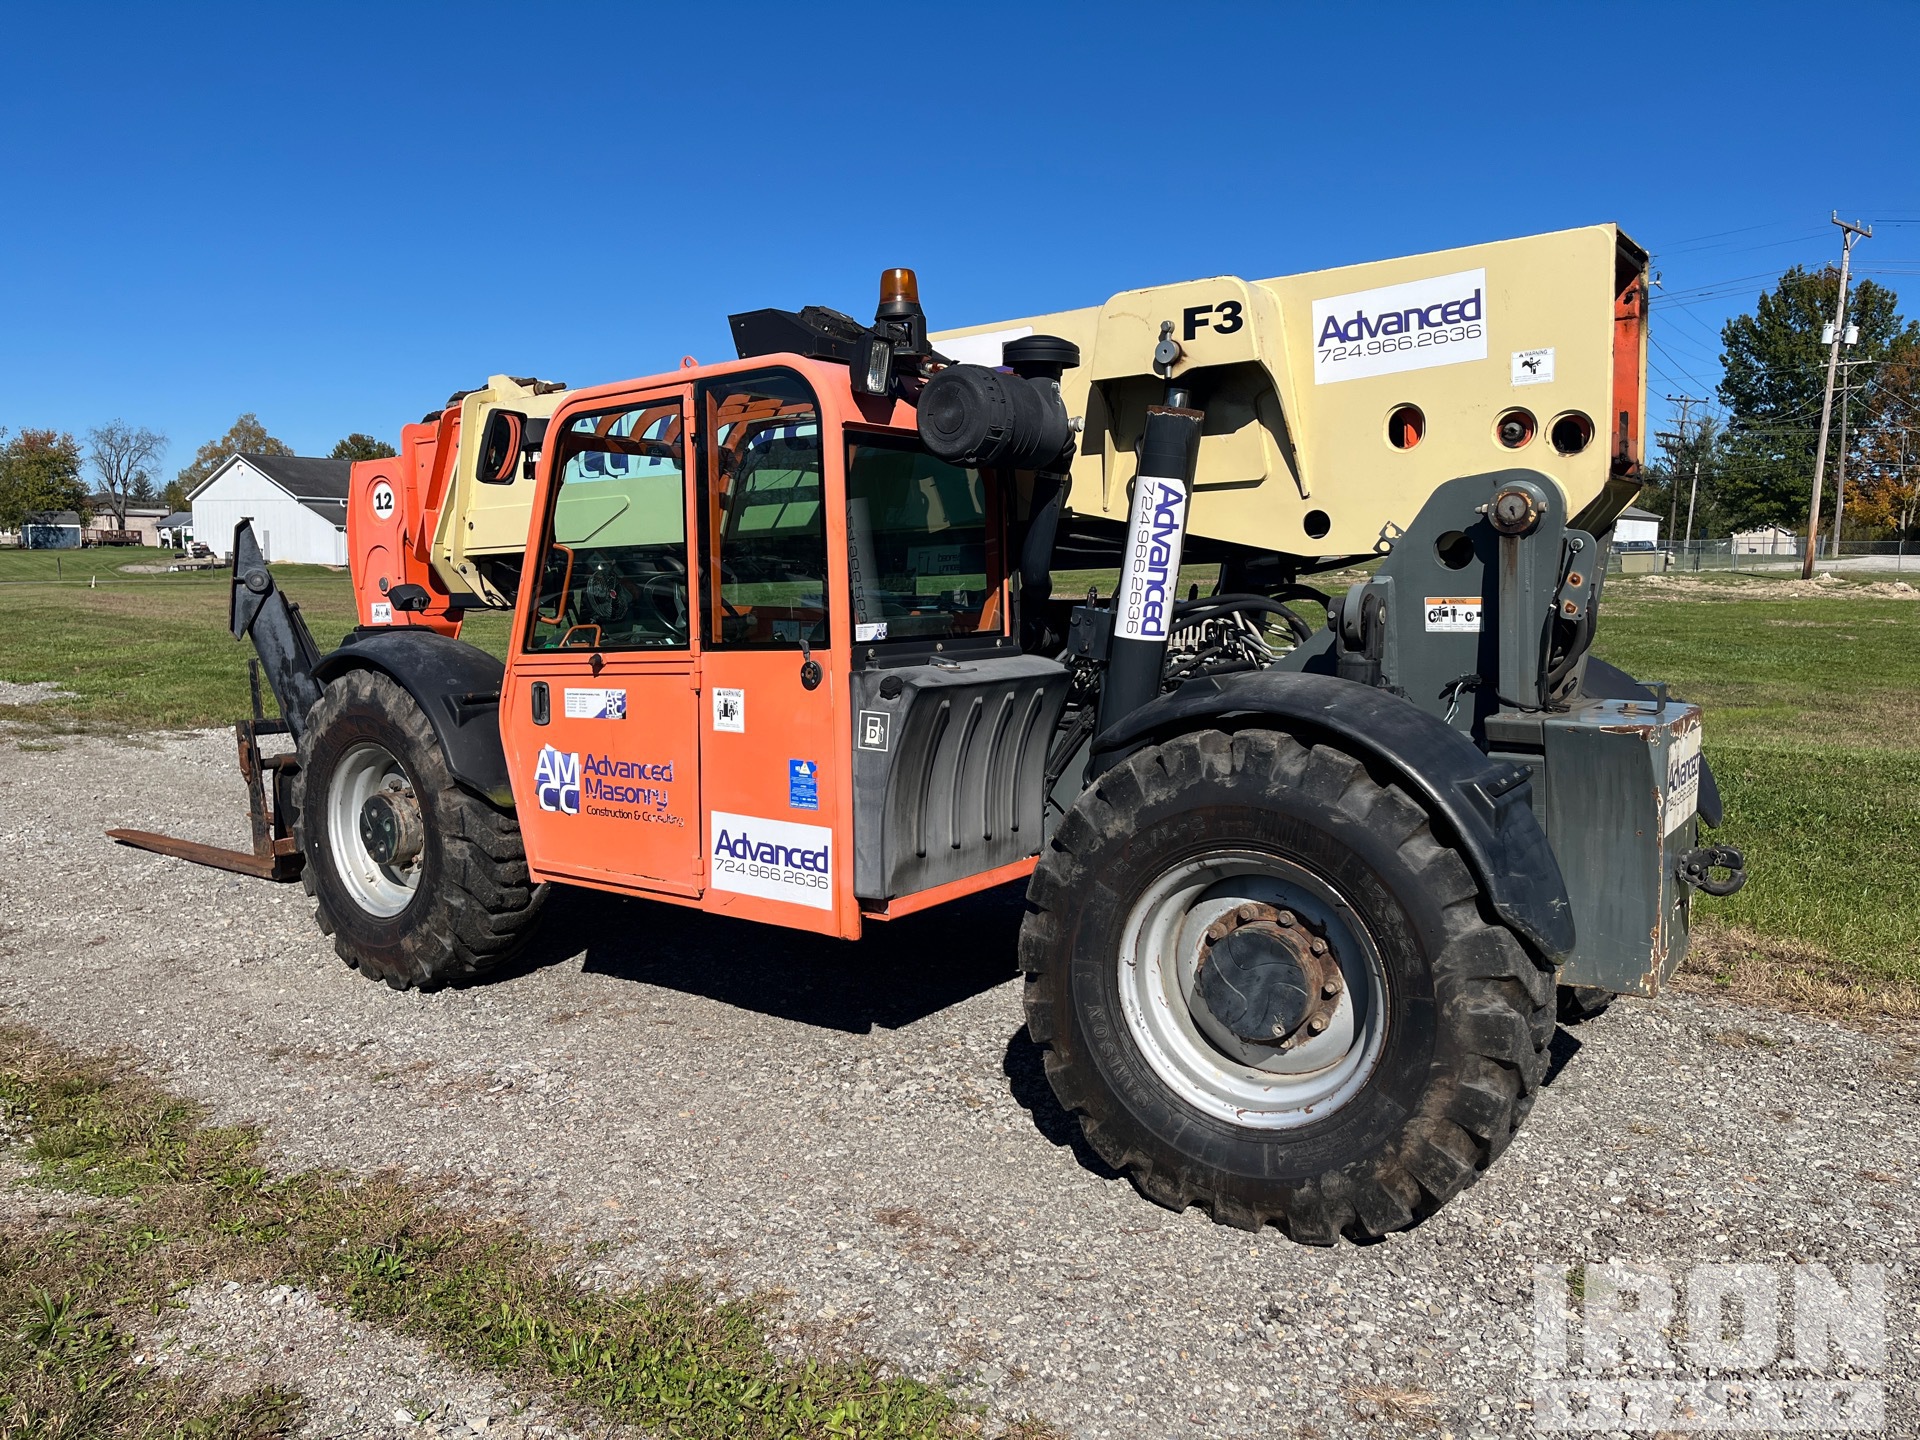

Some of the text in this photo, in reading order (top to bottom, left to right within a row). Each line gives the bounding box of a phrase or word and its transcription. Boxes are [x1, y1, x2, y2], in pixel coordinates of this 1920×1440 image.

[1183, 300, 1243, 342] F3
[1318, 288, 1482, 348] Advanced
[1318, 323, 1482, 364] 724.966.2636
[375, 492, 393, 510] 12
[1126, 481, 1156, 634] 724.966.2636
[1141, 482, 1184, 637] Advanced
[869, 728, 877, 739] D
[534, 748, 580, 790] AM
[583, 753, 674, 782] Advanced
[584, 777, 669, 812] Masonry
[586, 804, 633, 821] Construction
[633, 810, 641, 821] &
[714, 828, 829, 874] Advanced
[714, 858, 829, 890] 724.966.2636
[1086, 1004, 1154, 1109] SAMSON
